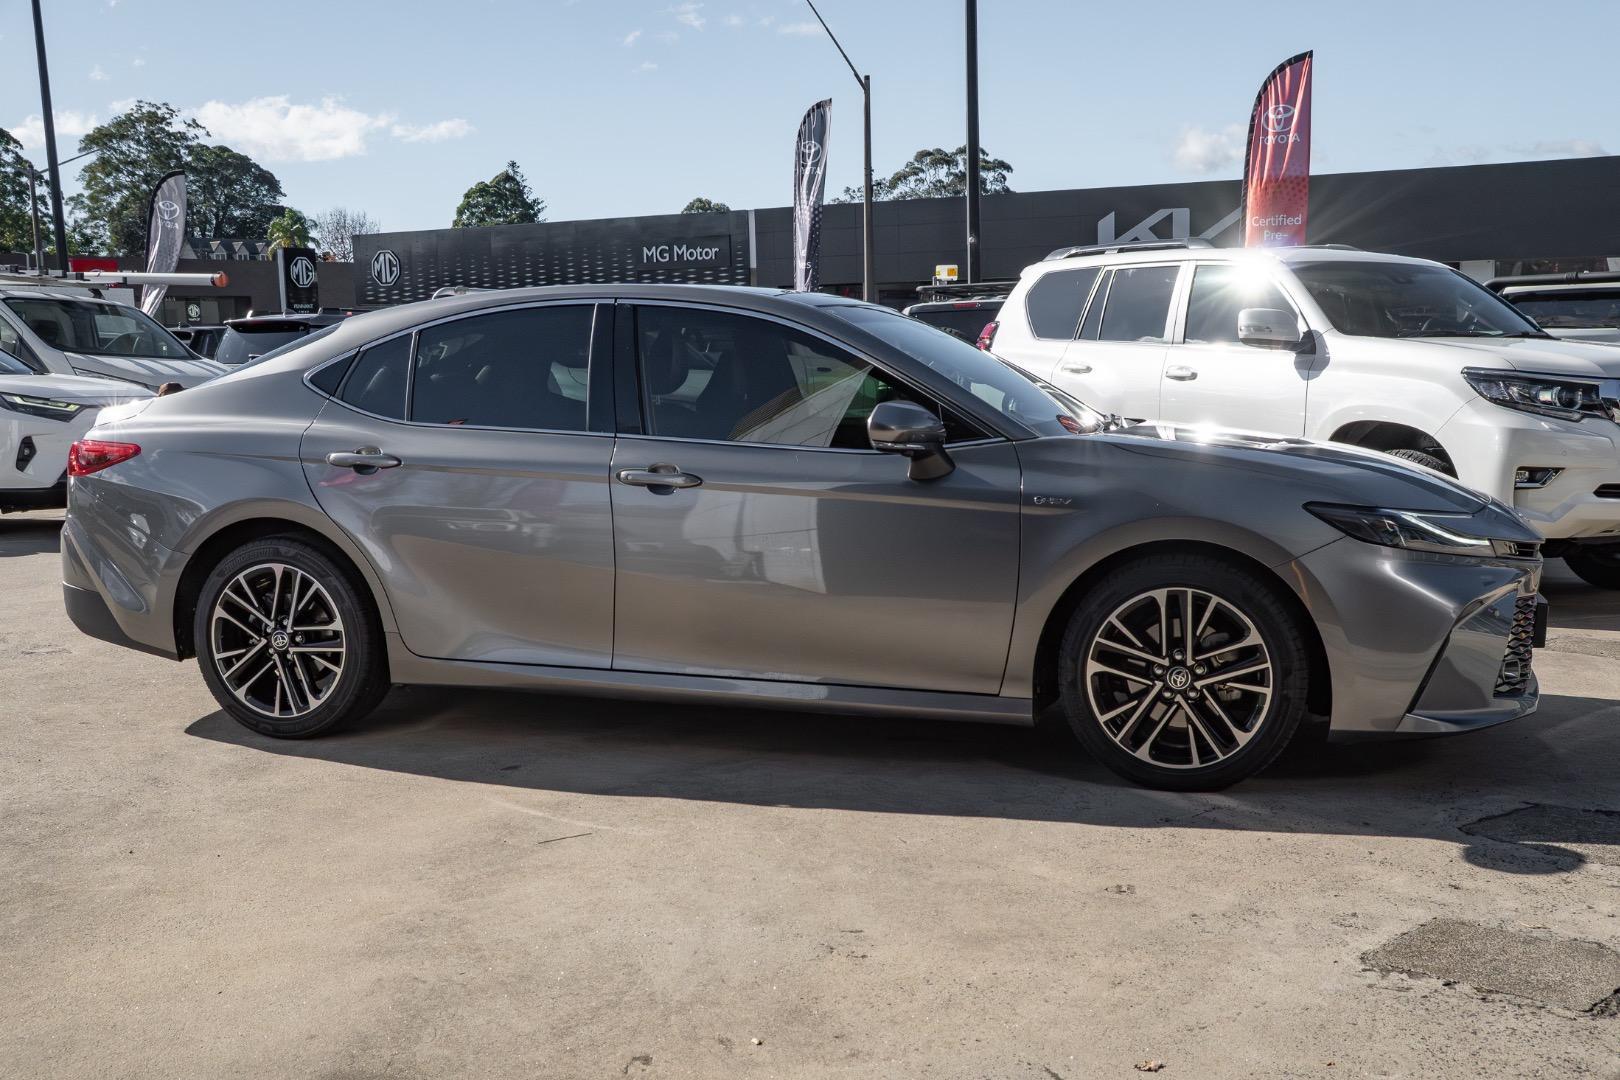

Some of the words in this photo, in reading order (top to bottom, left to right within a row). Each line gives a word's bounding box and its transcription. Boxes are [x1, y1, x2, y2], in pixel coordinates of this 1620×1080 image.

[1259, 133, 1301, 144] TOYOTA
[1252, 213, 1302, 226] Certified
[1263, 229, 1289, 241] Pre-
[642, 245, 670, 263] MG
[673, 244, 720, 262] Motor
[292, 259, 313, 285] MG
[373, 252, 398, 284] MG
